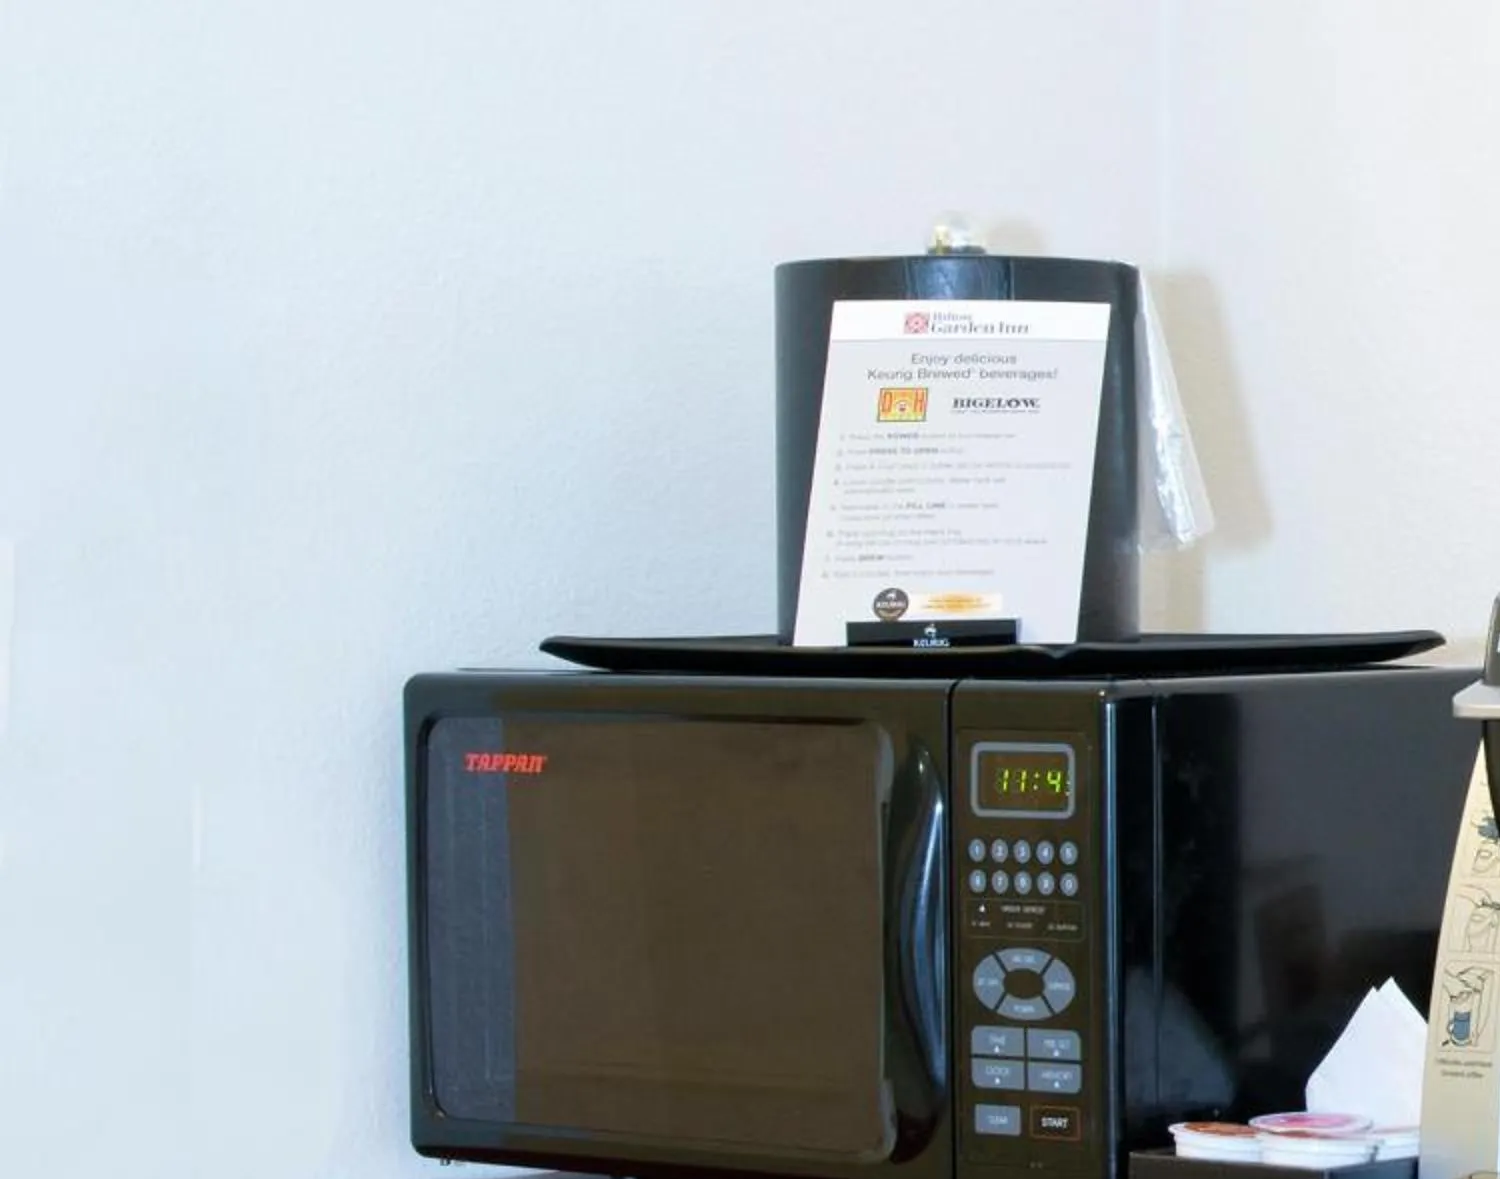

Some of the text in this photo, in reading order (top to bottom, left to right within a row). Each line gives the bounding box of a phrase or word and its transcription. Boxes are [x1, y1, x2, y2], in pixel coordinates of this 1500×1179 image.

[911, 353, 1017, 366] Enjoy delicious
[979, 368, 1058, 381] beverages!
[465, 752, 545, 773] TAPPAN
[1001, 768, 1071, 796] 11:4
[1041, 1116, 1069, 1129] START
